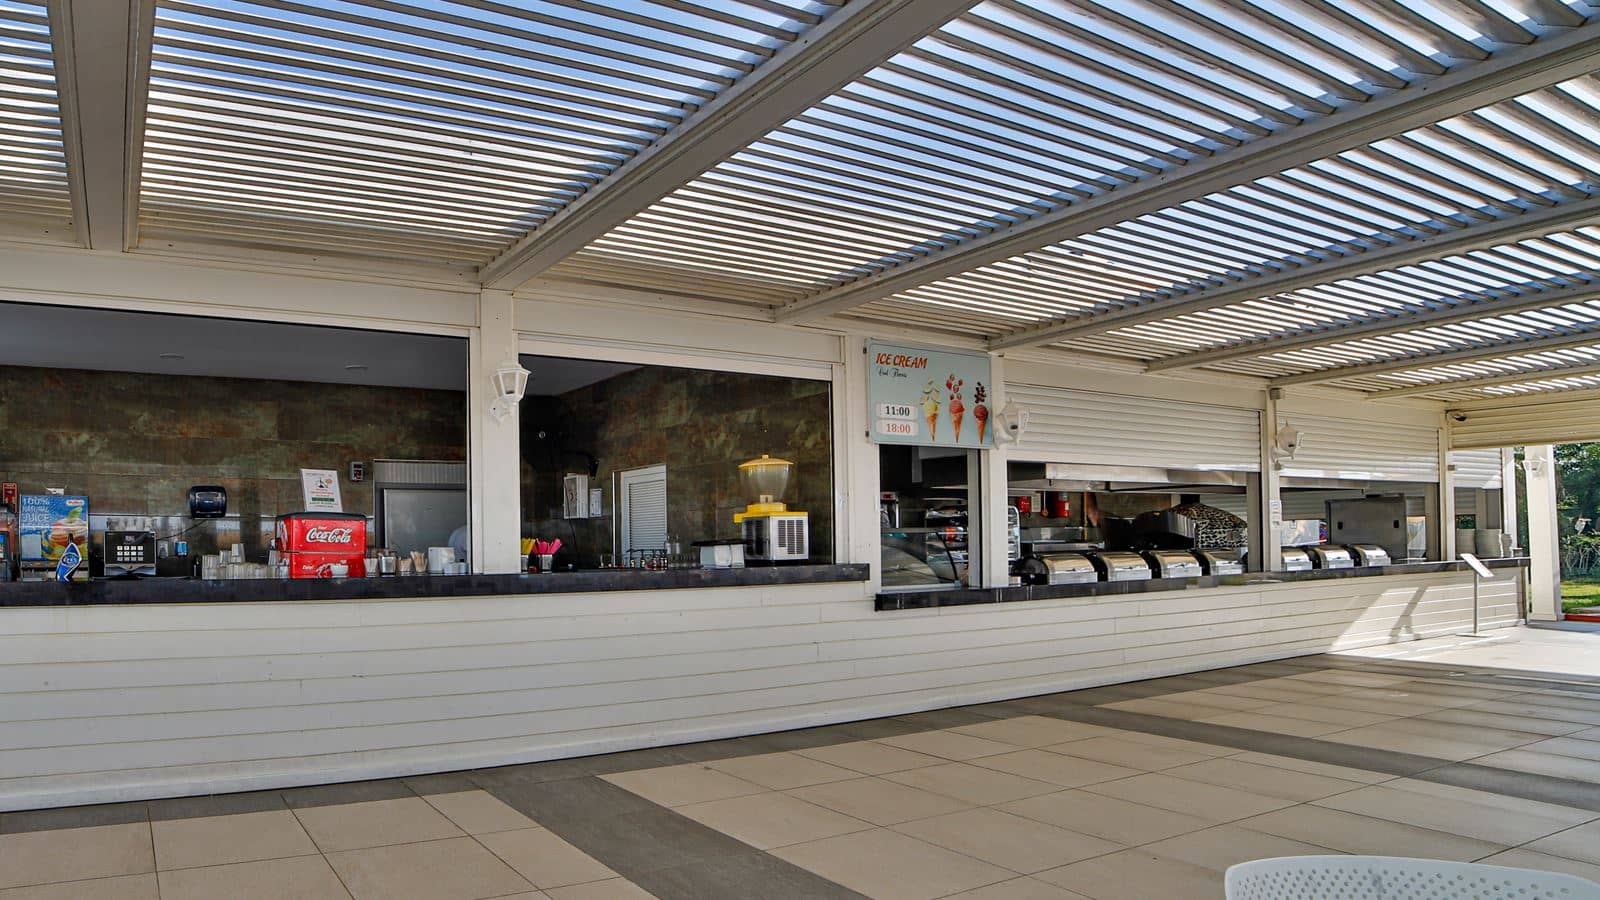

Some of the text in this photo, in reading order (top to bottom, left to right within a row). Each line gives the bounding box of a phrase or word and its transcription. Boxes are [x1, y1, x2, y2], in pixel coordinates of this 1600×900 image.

[876, 353, 928, 368] ICE CREAM
[885, 405, 910, 417] 11:00
[886, 423, 911, 433] 18:00
[23, 497, 50, 505] 100%
[22, 512, 49, 522] JUICE
[306, 528, 352, 543] Coca-Cola
